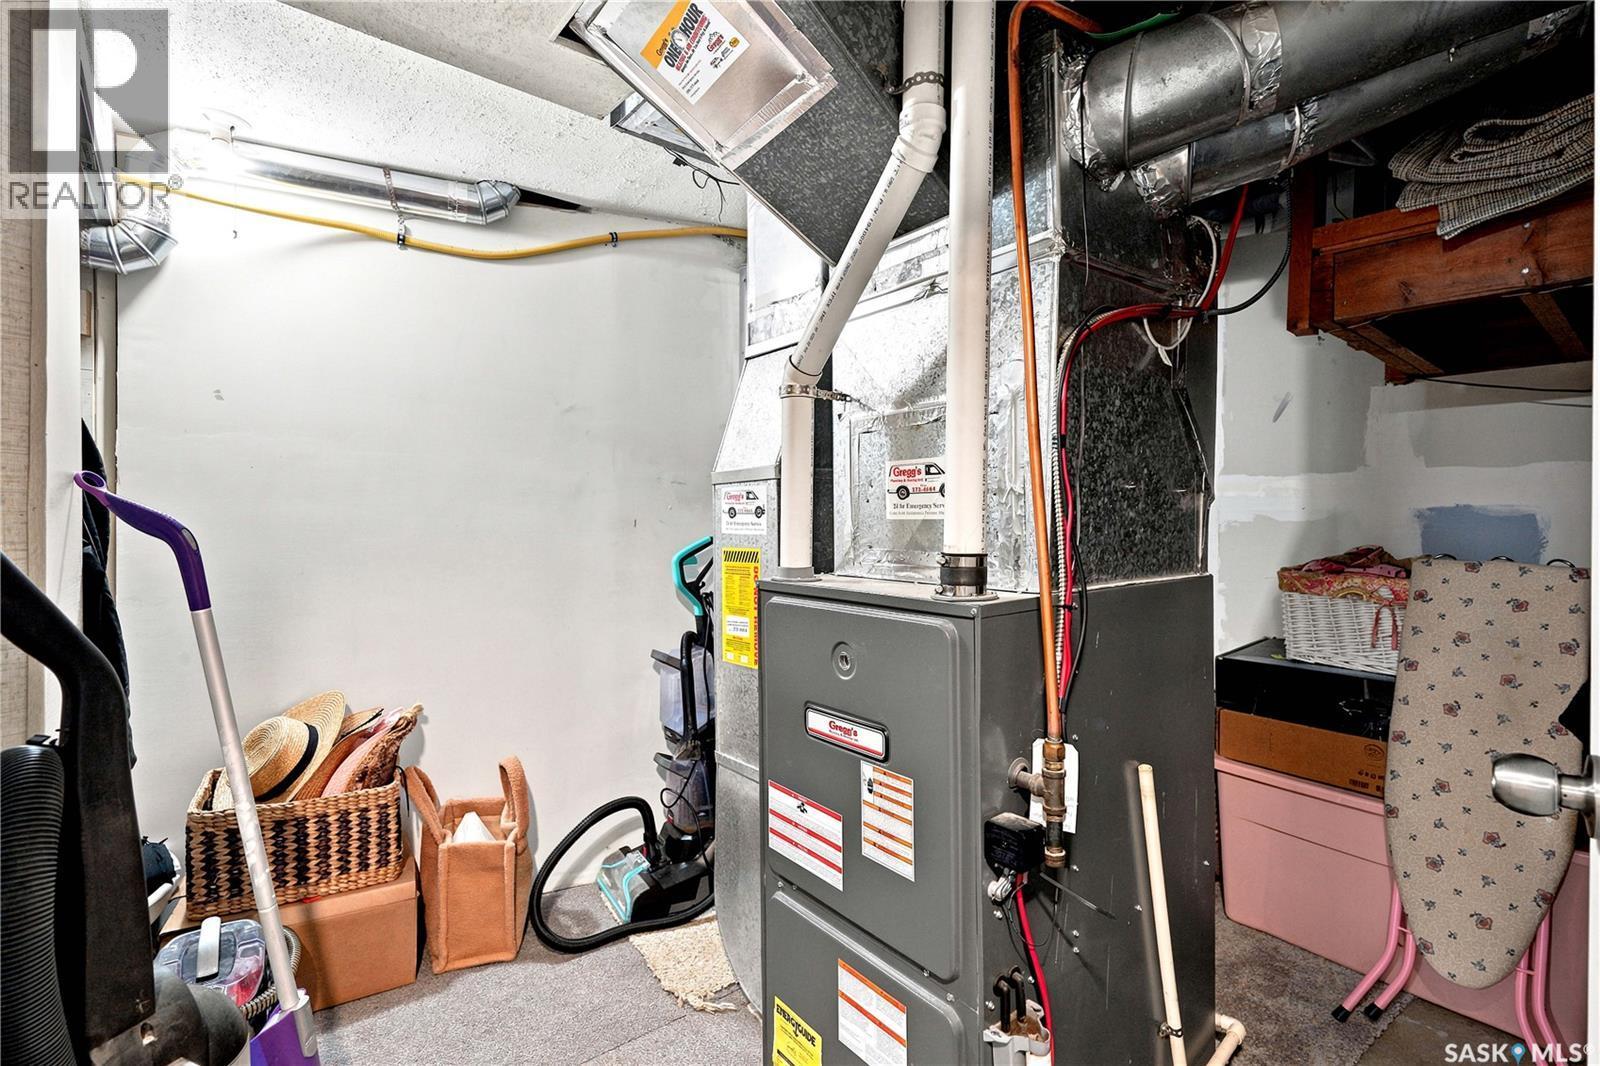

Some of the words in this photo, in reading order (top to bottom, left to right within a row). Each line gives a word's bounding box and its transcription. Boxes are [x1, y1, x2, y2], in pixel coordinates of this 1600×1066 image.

[664, 41, 682, 68] ONE
[679, 3, 704, 38] HOUR
[893, 466, 922, 478] Gregg's
[829, 720, 858, 736] Gregg's
